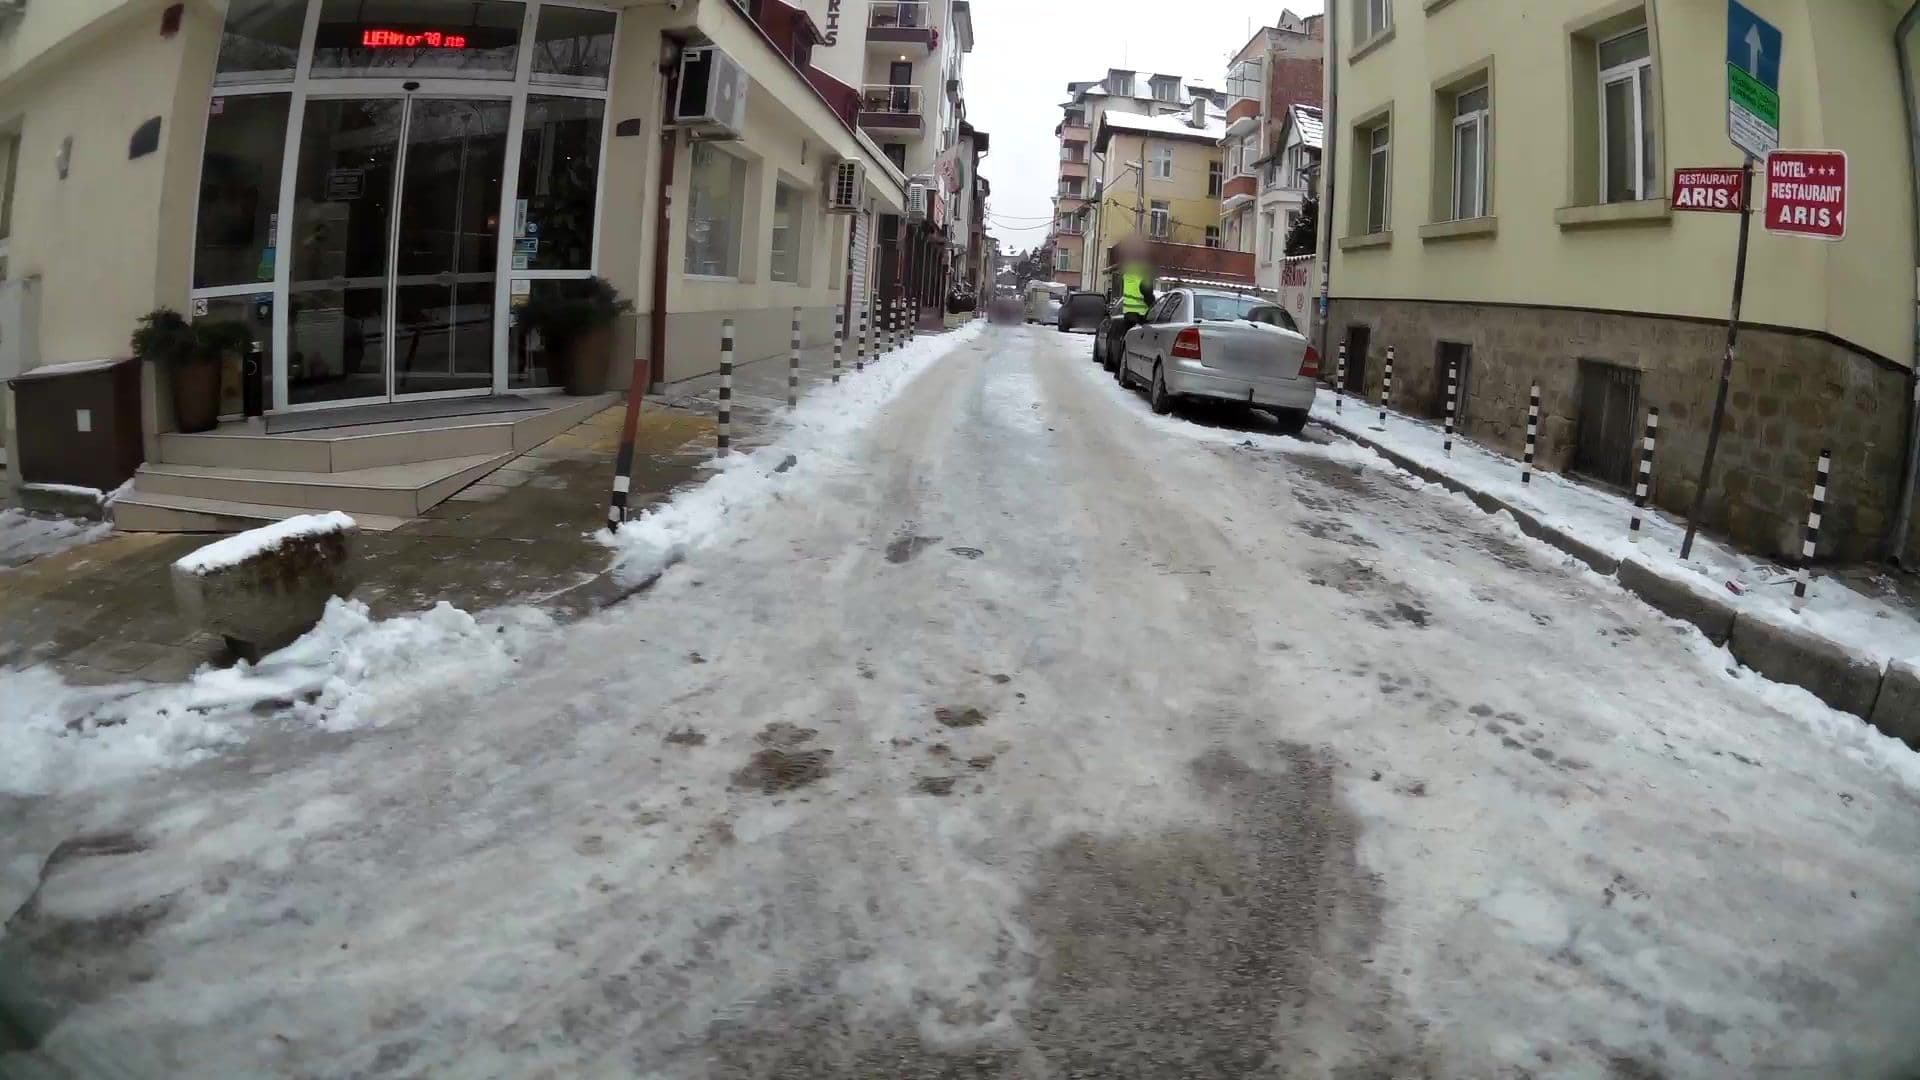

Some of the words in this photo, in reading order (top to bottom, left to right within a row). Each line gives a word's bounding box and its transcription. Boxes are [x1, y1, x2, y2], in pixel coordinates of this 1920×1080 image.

[1679, 173, 1739, 185] RESTAURANT
[1772, 161, 1806, 178] HOTEL
[1676, 188, 1730, 208] ARIS
[1771, 182, 1842, 203] RESTAURANT
[1778, 205, 1831, 228] ARIS
